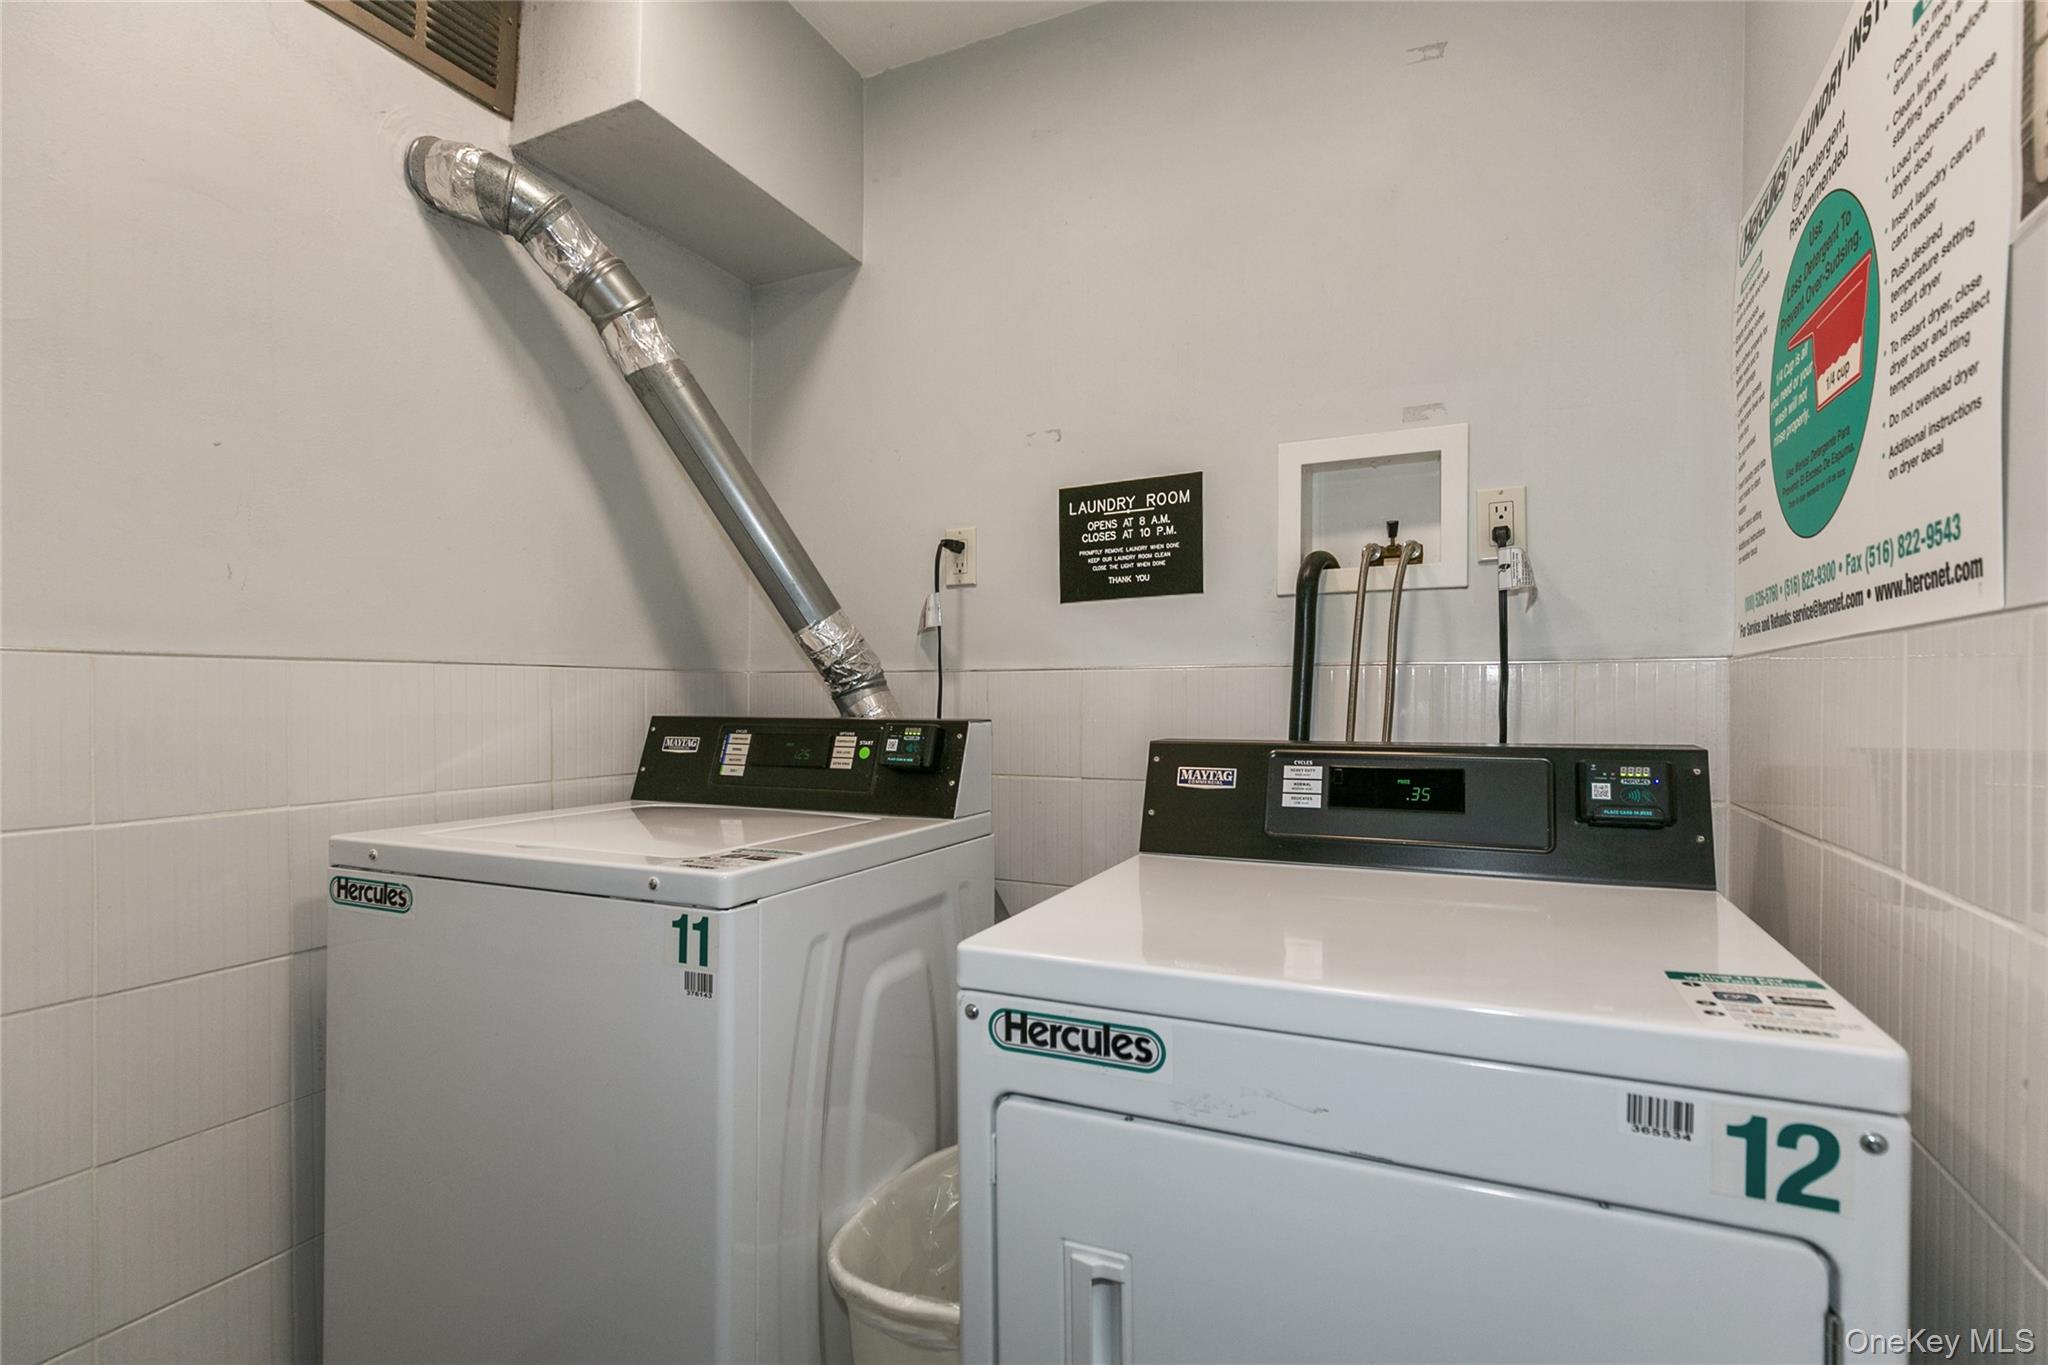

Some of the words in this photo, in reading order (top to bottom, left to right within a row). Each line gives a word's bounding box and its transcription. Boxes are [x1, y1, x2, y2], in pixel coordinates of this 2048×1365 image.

[1893, 34, 1918, 74] Check
[1920, 19, 1930, 37] to
[1893, 61, 1914, 95] drum
[1925, 8, 1953, 53] empty
[1893, 91, 1916, 126] Clean
[1917, 70, 1931, 96] lint
[1932, 41, 1953, 77] filter
[1955, 0, 1989, 47] before
[1893, 105, 1922, 148] starting
[1925, 71, 1949, 108] dryer
[1893, 144, 1912, 179] Load
[1913, 110, 1945, 154] clothes
[1947, 82, 1966, 116] and
[1968, 50, 1997, 91] close
[1742, 156, 1790, 259] Hercules
[1791, 47, 1846, 171] LAUNDRY
[1806, 109, 1846, 188] Detergent
[1892, 169, 1912, 200] dryer
[1914, 144, 1934, 175] door
[1789, 134, 1849, 240] Recommended
[1892, 197, 1914, 231] Insert
[1915, 162, 1948, 206] laundry
[1950, 133, 1973, 169] card
[1975, 126, 1985, 144] in
[1808, 219, 1824, 247] Use
[1891, 223, 1909, 252] card
[1910, 197, 1938, 233] reader
[1891, 256, 1910, 283] Push
[1911, 221, 1943, 263] desired
[1787, 275, 1802, 303] Less
[1803, 220, 1840, 281] Detergent
[1841, 209, 1852, 231] To
[1891, 252, 1939, 304] temperature
[1941, 219, 1976, 258] setting
[1780, 295, 1805, 336] Prevent
[1889, 340, 1899, 354] To
[1900, 315, 1926, 347] restart
[1928, 297, 1953, 325] dryer,
[1955, 273, 1983, 303] close
[1890, 310, 1899, 325] to
[1900, 290, 1918, 317] start
[1919, 271, 1942, 299] dryer
[1889, 353, 1909, 376] dryer
[1910, 337, 1929, 361] door
[1931, 320, 1948, 345] and
[1950, 289, 1990, 331] reselect
[1826, 371, 1836, 390] 1/4
[1836, 361, 1850, 382] cup
[1889, 355, 1937, 397] temperature
[1938, 330, 1971, 362] setting
[1889, 413, 1899, 428] Do
[1901, 402, 1914, 421] not
[1914, 375, 1952, 411] overload
[1953, 360, 1980, 387] dryer
[1888, 425, 1927, 459] Additional
[1928, 396, 1983, 437] instructions
[1888, 466, 1898, 480] on
[1899, 453, 1919, 474] dryer
[1920, 438, 1944, 463] decal
[1068, 496, 1136, 516] LAUNDRY
[1146, 489, 1191, 507] ROOM
[1087, 519, 1118, 531] OPENS
[1122, 517, 1134, 528] AT
[1138, 515, 1146, 526] 8
[1151, 513, 1171, 525] A.M.
[1079, 549, 1103, 557] PROMPTLY
[1104, 547, 1124, 555] REMOVE
[1126, 545, 1148, 553] LAUNDRY
[1166, 541, 1180, 549] DONE
[1081, 531, 1117, 543] CLOSES
[1122, 529, 1134, 540] AT
[1140, 527, 1151, 538] 10
[1156, 525, 1177, 537] P.M.
[1087, 556, 1100, 564] KEEP
[1114, 554, 1136, 562] LAUNDRY
[1138, 552, 1153, 560] ROOM
[1154, 551, 1171, 559] CLEAN
[1784, 573, 1801, 602] (516)
[1801, 560, 1837, 592] 822-9300
[1845, 553, 1862, 576] Fax
[1865, 538, 1894, 575] (516)
[1897, 513, 1962, 559] 822-9543
[1108, 575, 1132, 584] THANK
[1135, 573, 1150, 582] YOU
[1136, 560, 1151, 568] WHEN
[1152, 559, 1166, 567] DONE
[1792, 590, 1864, 624] service@hercnet.com
[1874, 557, 1984, 602] www.hercnet.com
[664, 738, 698, 748] MAYTAG
[1180, 769, 1234, 782] MAYTAG
[336, 877, 407, 907] Hercules
[672, 913, 709, 967] 11
[1004, 1009, 1153, 1064] Hercules
[1631, 1124, 1692, 1141] 365534
[1726, 1115, 1841, 1214] 12
